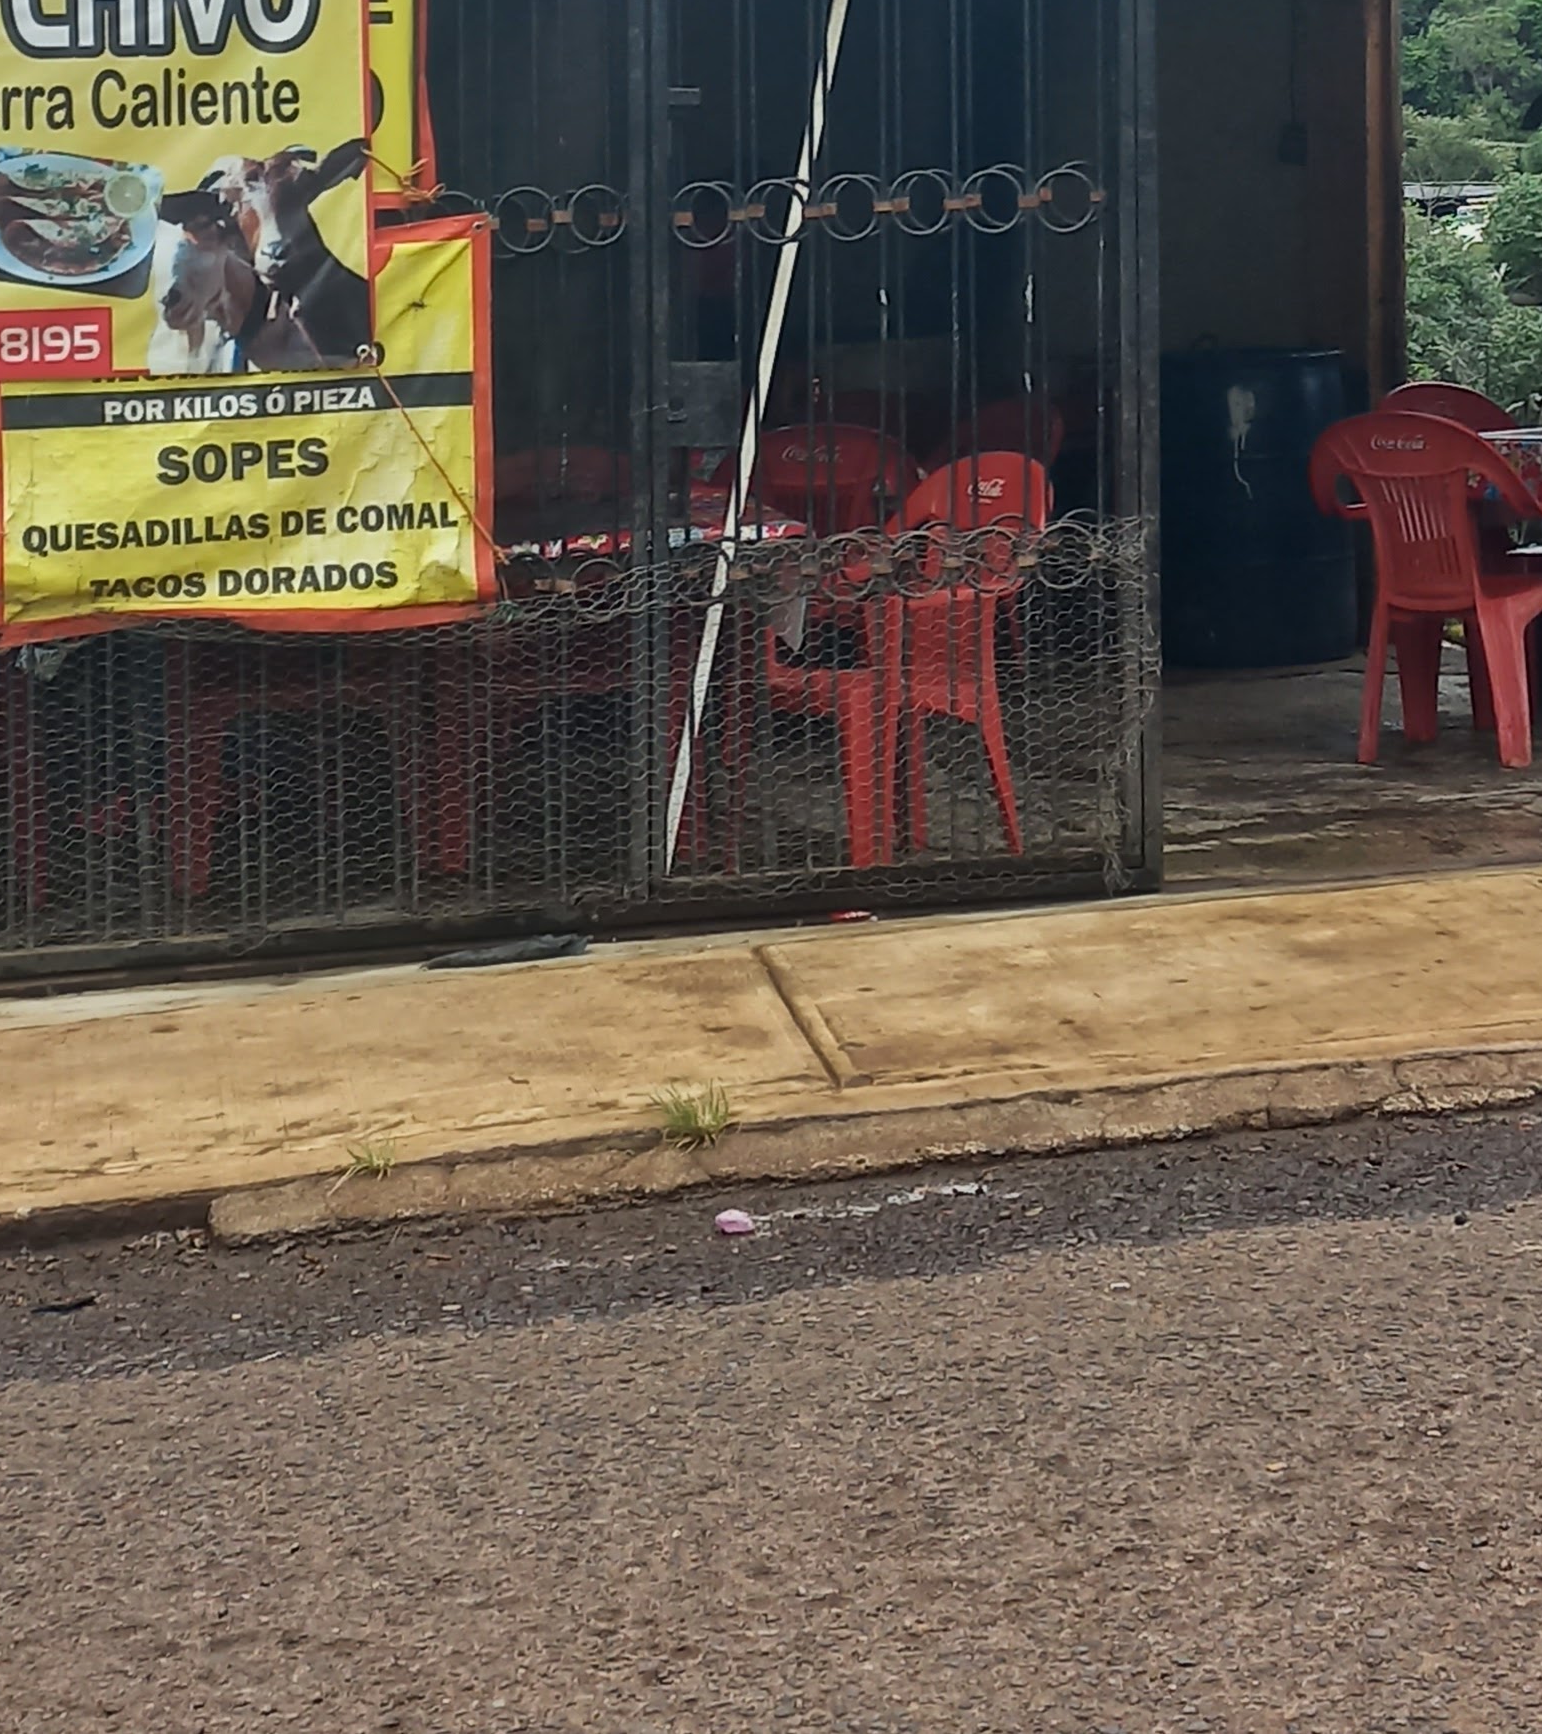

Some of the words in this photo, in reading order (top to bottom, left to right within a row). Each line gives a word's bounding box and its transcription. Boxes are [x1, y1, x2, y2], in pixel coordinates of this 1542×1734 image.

[91, 67, 300, 129] Caliente
[0, 324, 101, 363] 8195
[103, 399, 165, 423] POR
[173, 394, 258, 421] KILOS
[266, 386, 285, 415] Ó
[293, 386, 376, 413] PIEZA
[156, 437, 329, 486] SOPES
[22, 513, 270, 557] QUESADILLAS
[281, 508, 327, 536] DE
[336, 501, 458, 534] COMAL
[90, 572, 206, 598] TACOS
[218, 561, 398, 597] DORADOS
